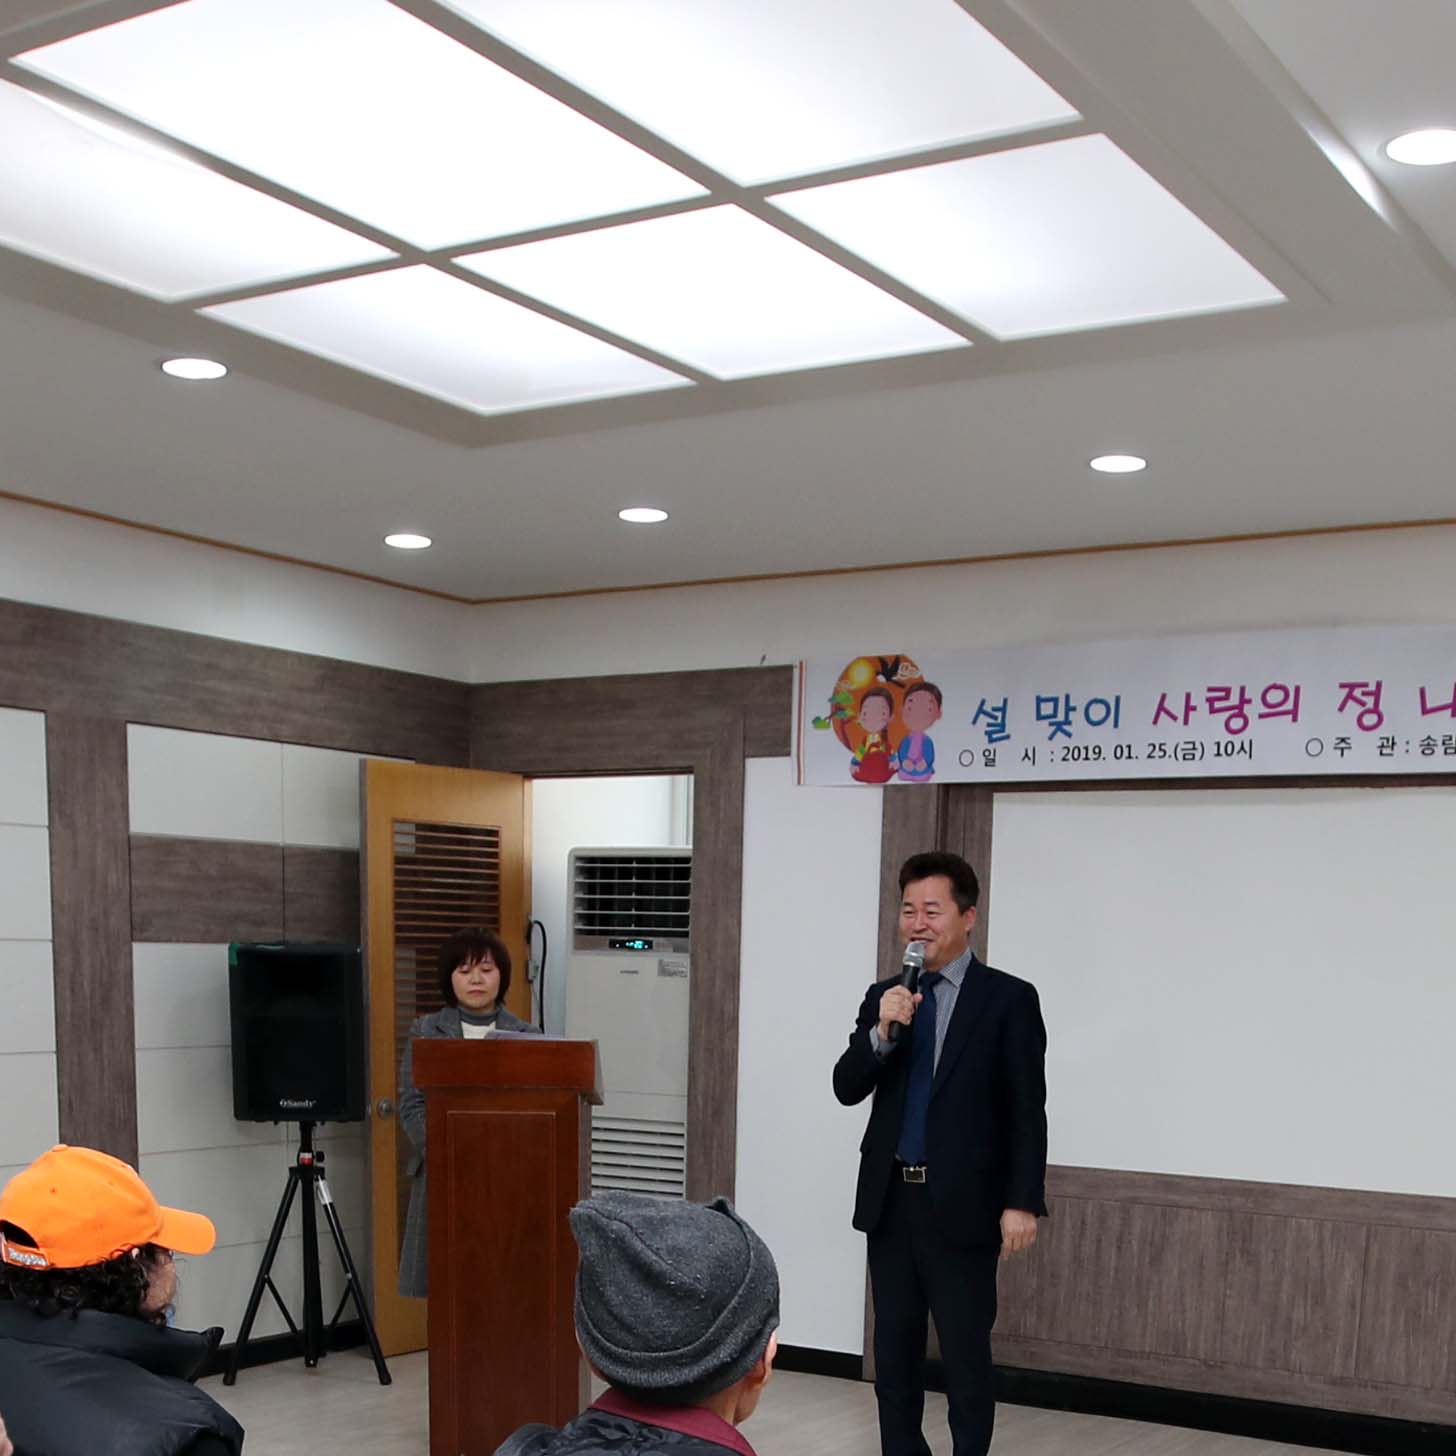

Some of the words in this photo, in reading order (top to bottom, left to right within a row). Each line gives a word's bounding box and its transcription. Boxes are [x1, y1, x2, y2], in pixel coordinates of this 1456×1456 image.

[971, 697, 1011, 744] 설
[1035, 693, 1121, 741] 맞이
[1151, 682, 1301, 735] 사랑의
[1337, 680, 1385, 732] 정
[982, 747, 997, 767] 일
[1021, 746, 1036, 766] 시
[1061, 744, 1106, 762] 2019.
[1113, 743, 1139, 761] 01.
[1146, 740, 1206, 762] 25.(금)
[1213, 738, 1253, 760] 10시
[1333, 736, 1353, 758] 주
[1376, 735, 1398, 757] 관
